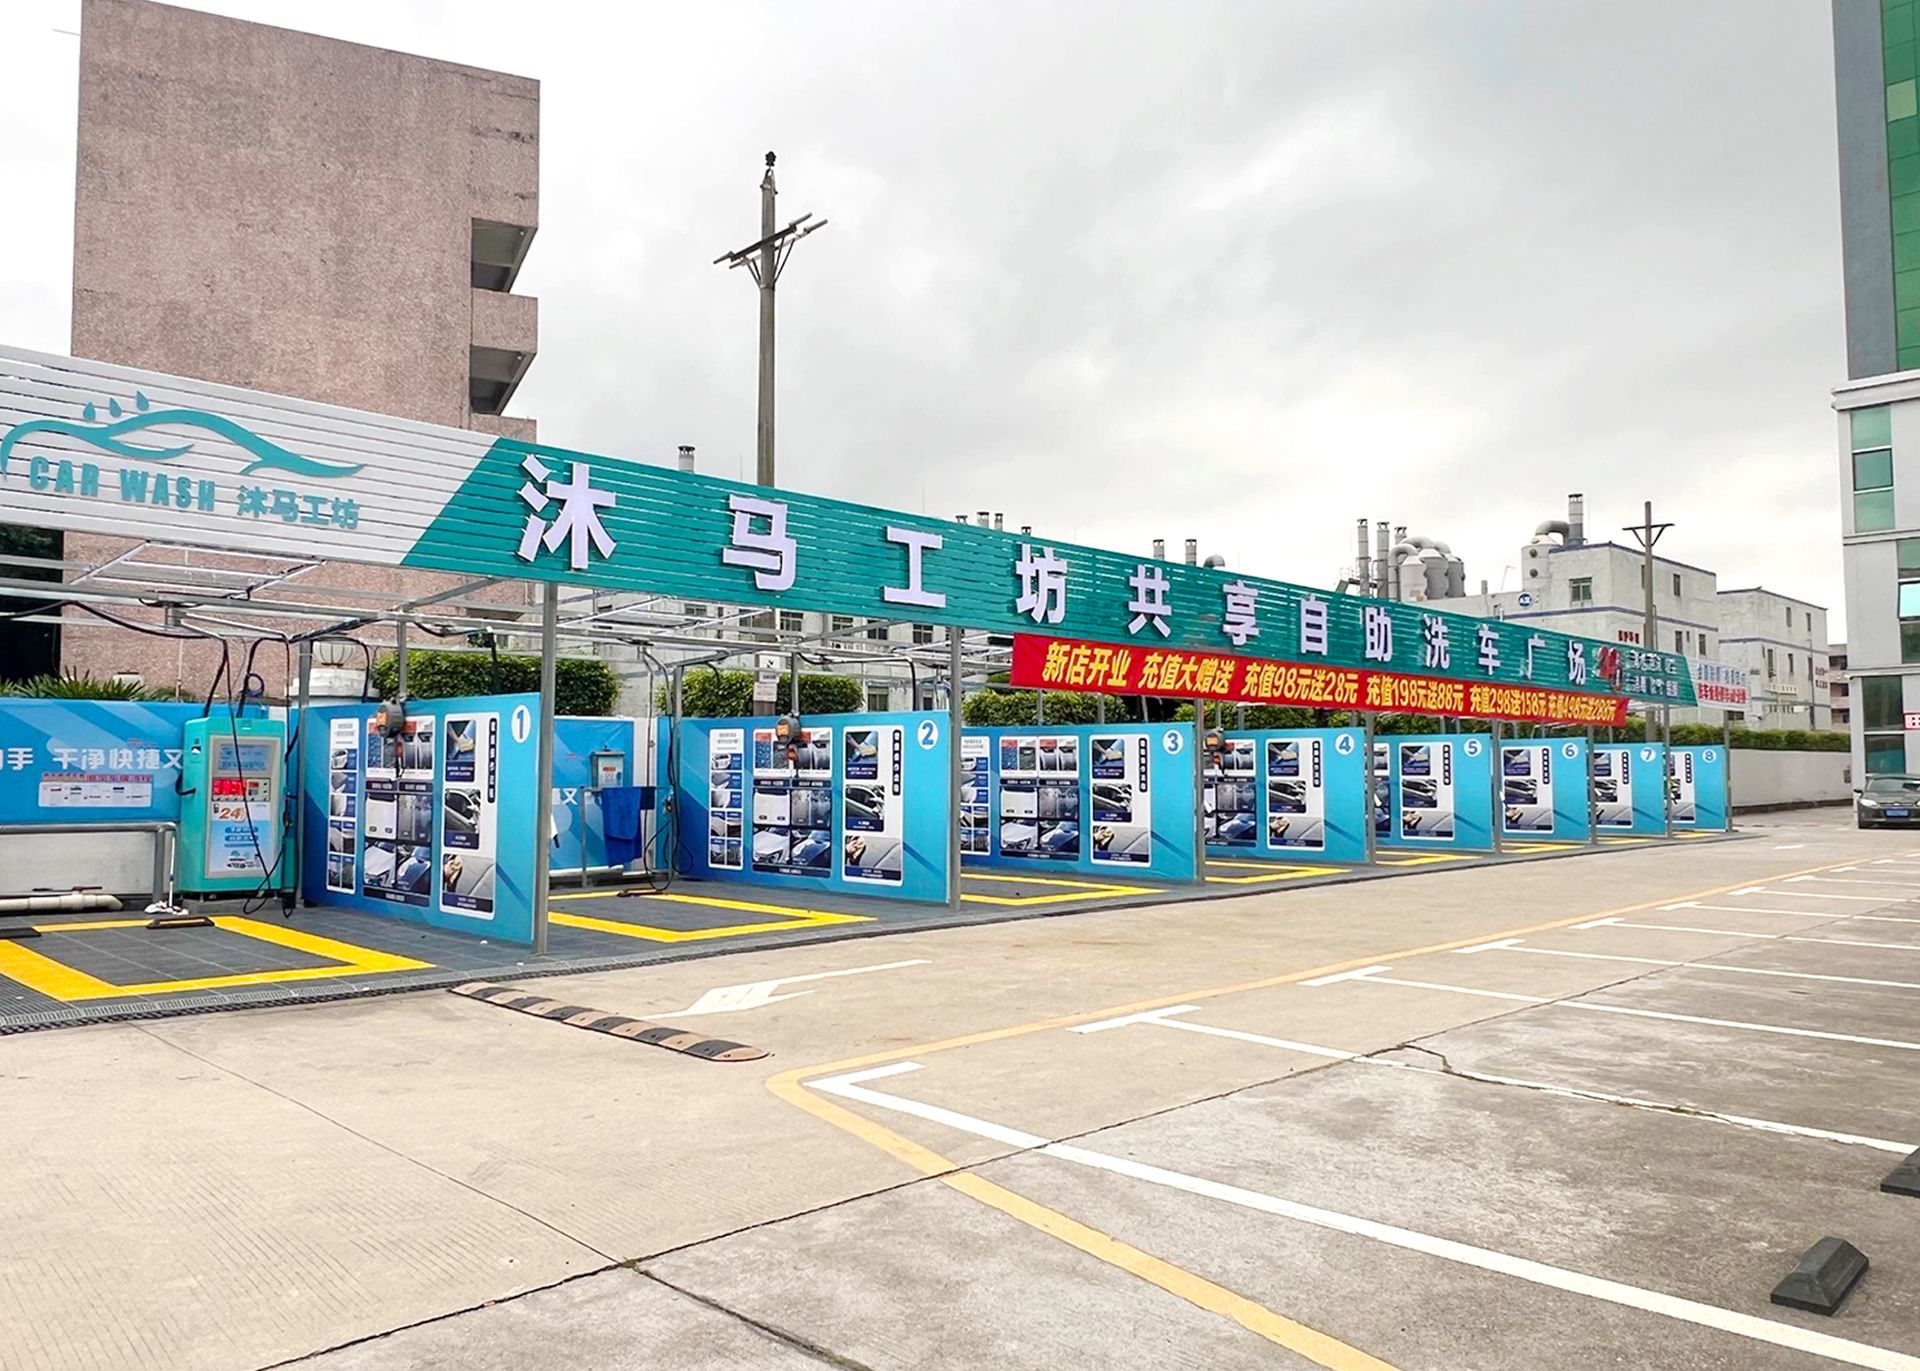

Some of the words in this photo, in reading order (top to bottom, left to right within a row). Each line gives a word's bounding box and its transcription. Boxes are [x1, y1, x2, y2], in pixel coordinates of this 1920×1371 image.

[30, 456, 100, 497] CAR
[119, 468, 216, 512] WASH
[236, 484, 361, 530] 沐马工坊
[1042, 641, 1132, 687] 新店开业
[1138, 652, 1236, 694] 充值大赠送
[1240, 662, 1359, 704] 充值98元送28元
[1365, 675, 1464, 712] 充值198元送88元
[53, 748, 183, 770] 干净快捷又
